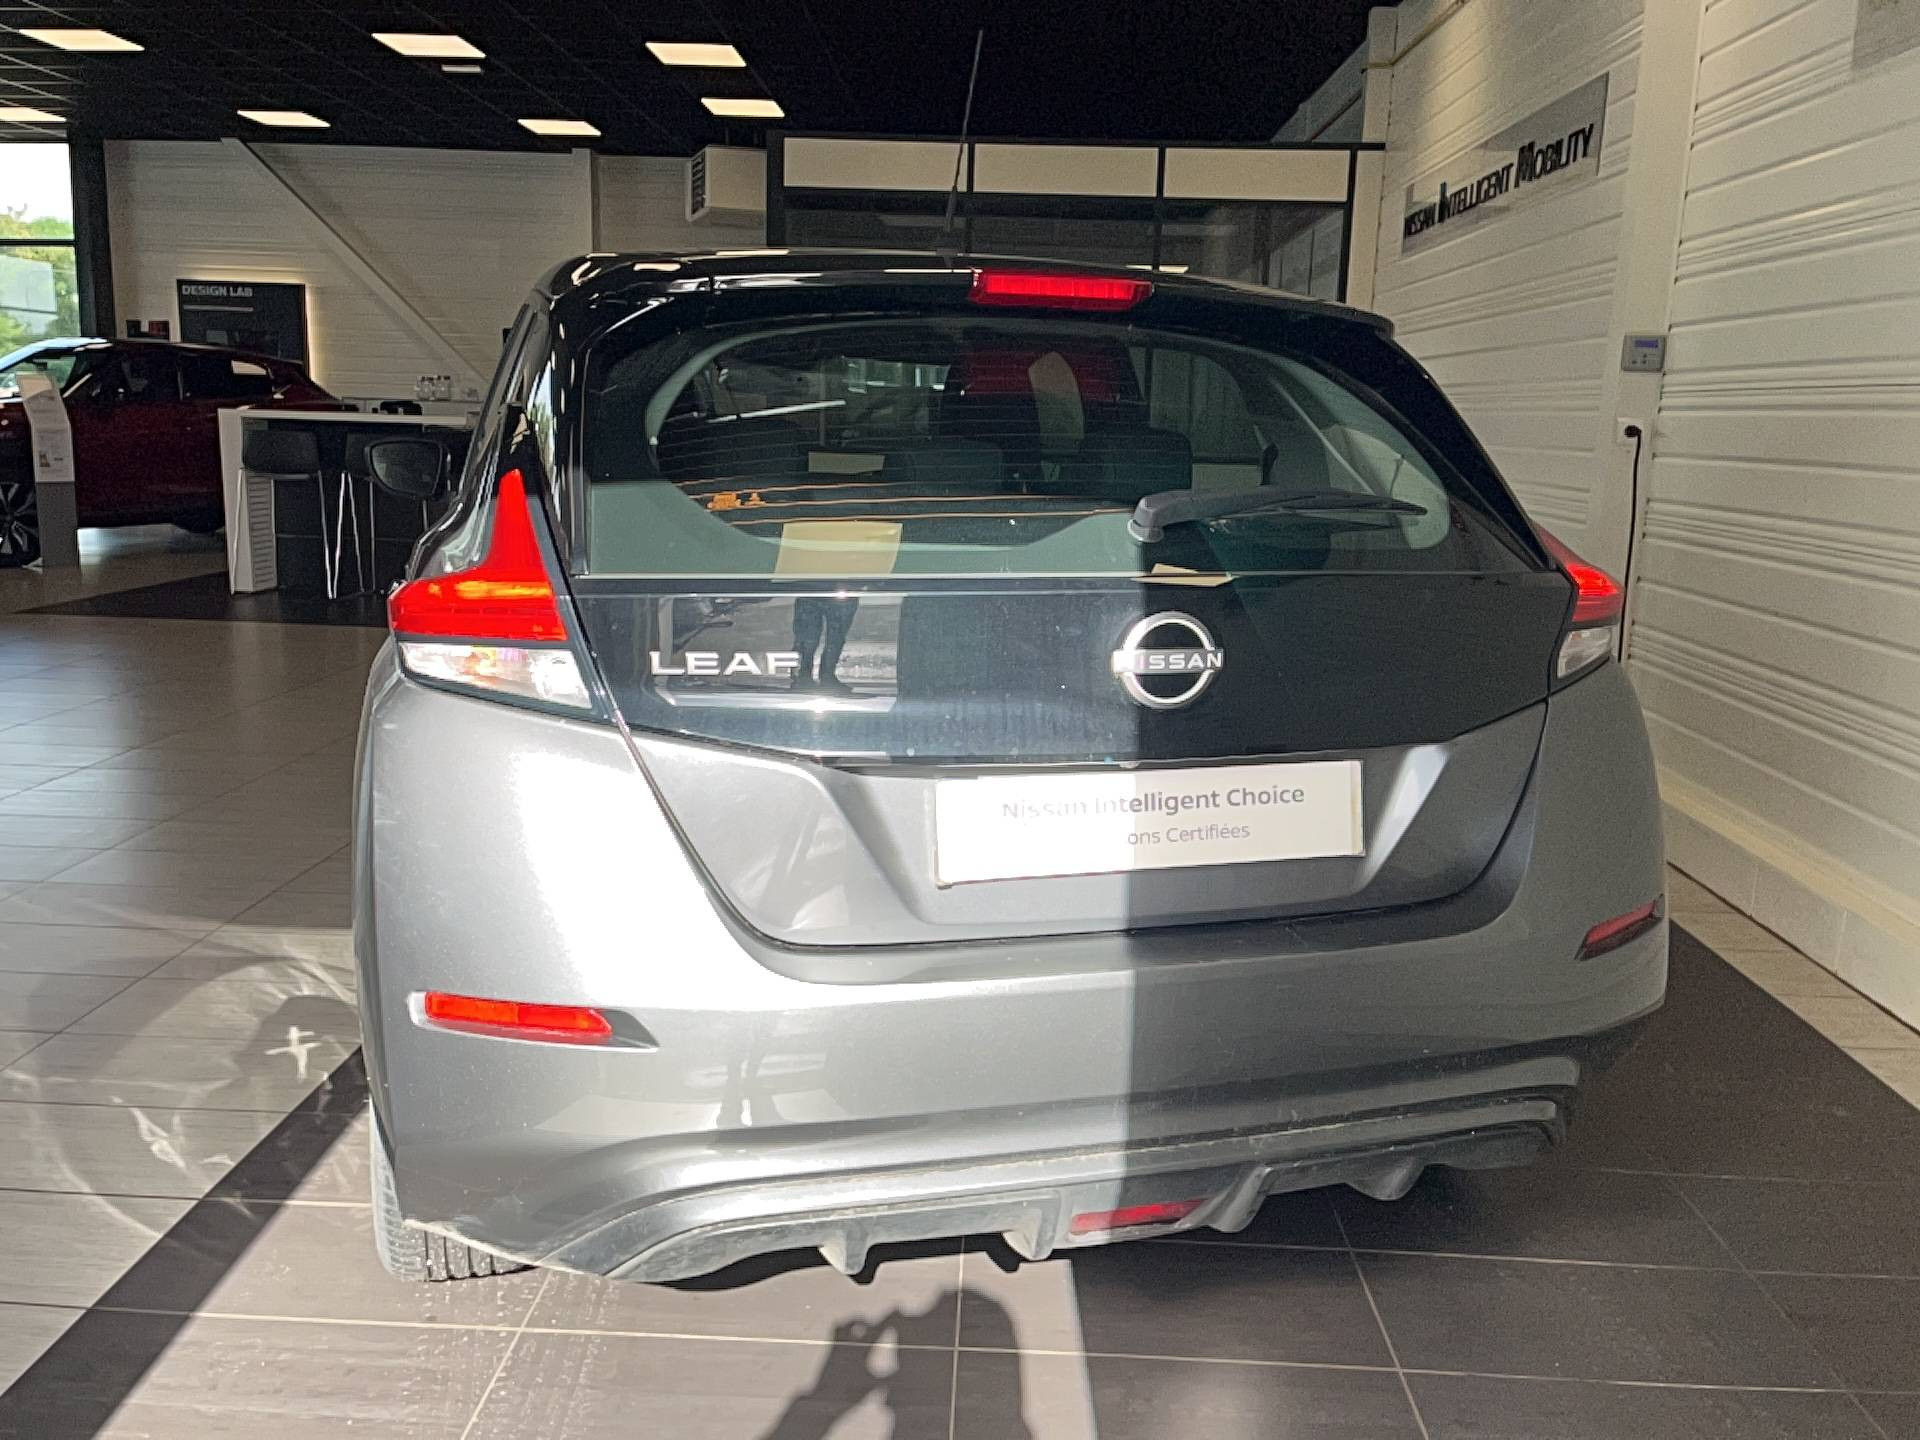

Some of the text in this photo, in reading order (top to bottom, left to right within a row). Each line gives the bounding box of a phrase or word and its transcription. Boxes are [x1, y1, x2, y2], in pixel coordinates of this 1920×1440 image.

[1514, 123, 1594, 189] MOBILITY
[182, 284, 253, 298] DESIGN LAB
[649, 650, 800, 676] LEAF
[1096, 789, 1221, 816] Intelligent
[1226, 785, 1305, 807] Choice
[1166, 822, 1251, 843] Certifiées
